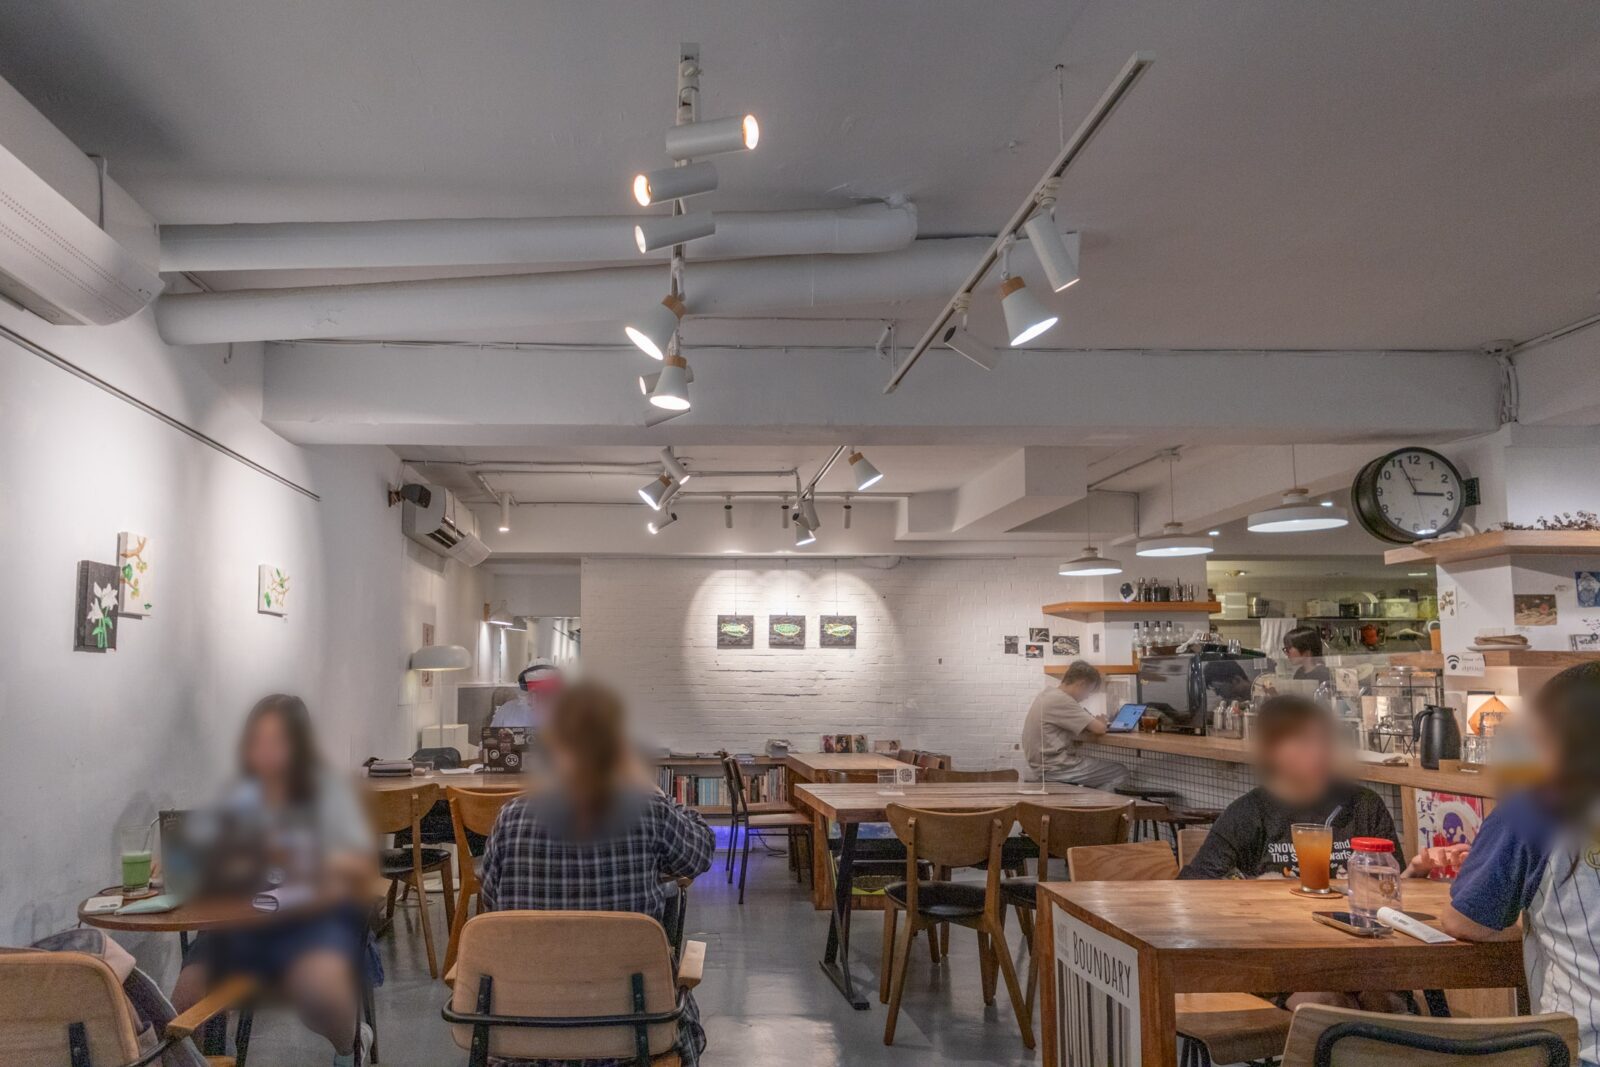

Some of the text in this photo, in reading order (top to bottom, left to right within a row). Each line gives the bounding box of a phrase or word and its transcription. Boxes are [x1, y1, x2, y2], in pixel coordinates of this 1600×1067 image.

[1391, 459, 1403, 468] 11
[1407, 455, 1420, 465] 12
[1429, 461, 1434, 470] 1
[1441, 474, 1448, 483] 2
[1376, 487, 1383, 496] 9
[1446, 491, 1454, 501] 3
[1381, 504, 1389, 514] 8
[1442, 508, 1449, 518] 4
[1394, 518, 1402, 527] 7
[1430, 519, 1438, 529] 5
[1333, 839, 1351, 849] and
[1271, 853, 1289, 863] The
[1073, 931, 1131, 998] BOUNDARY
